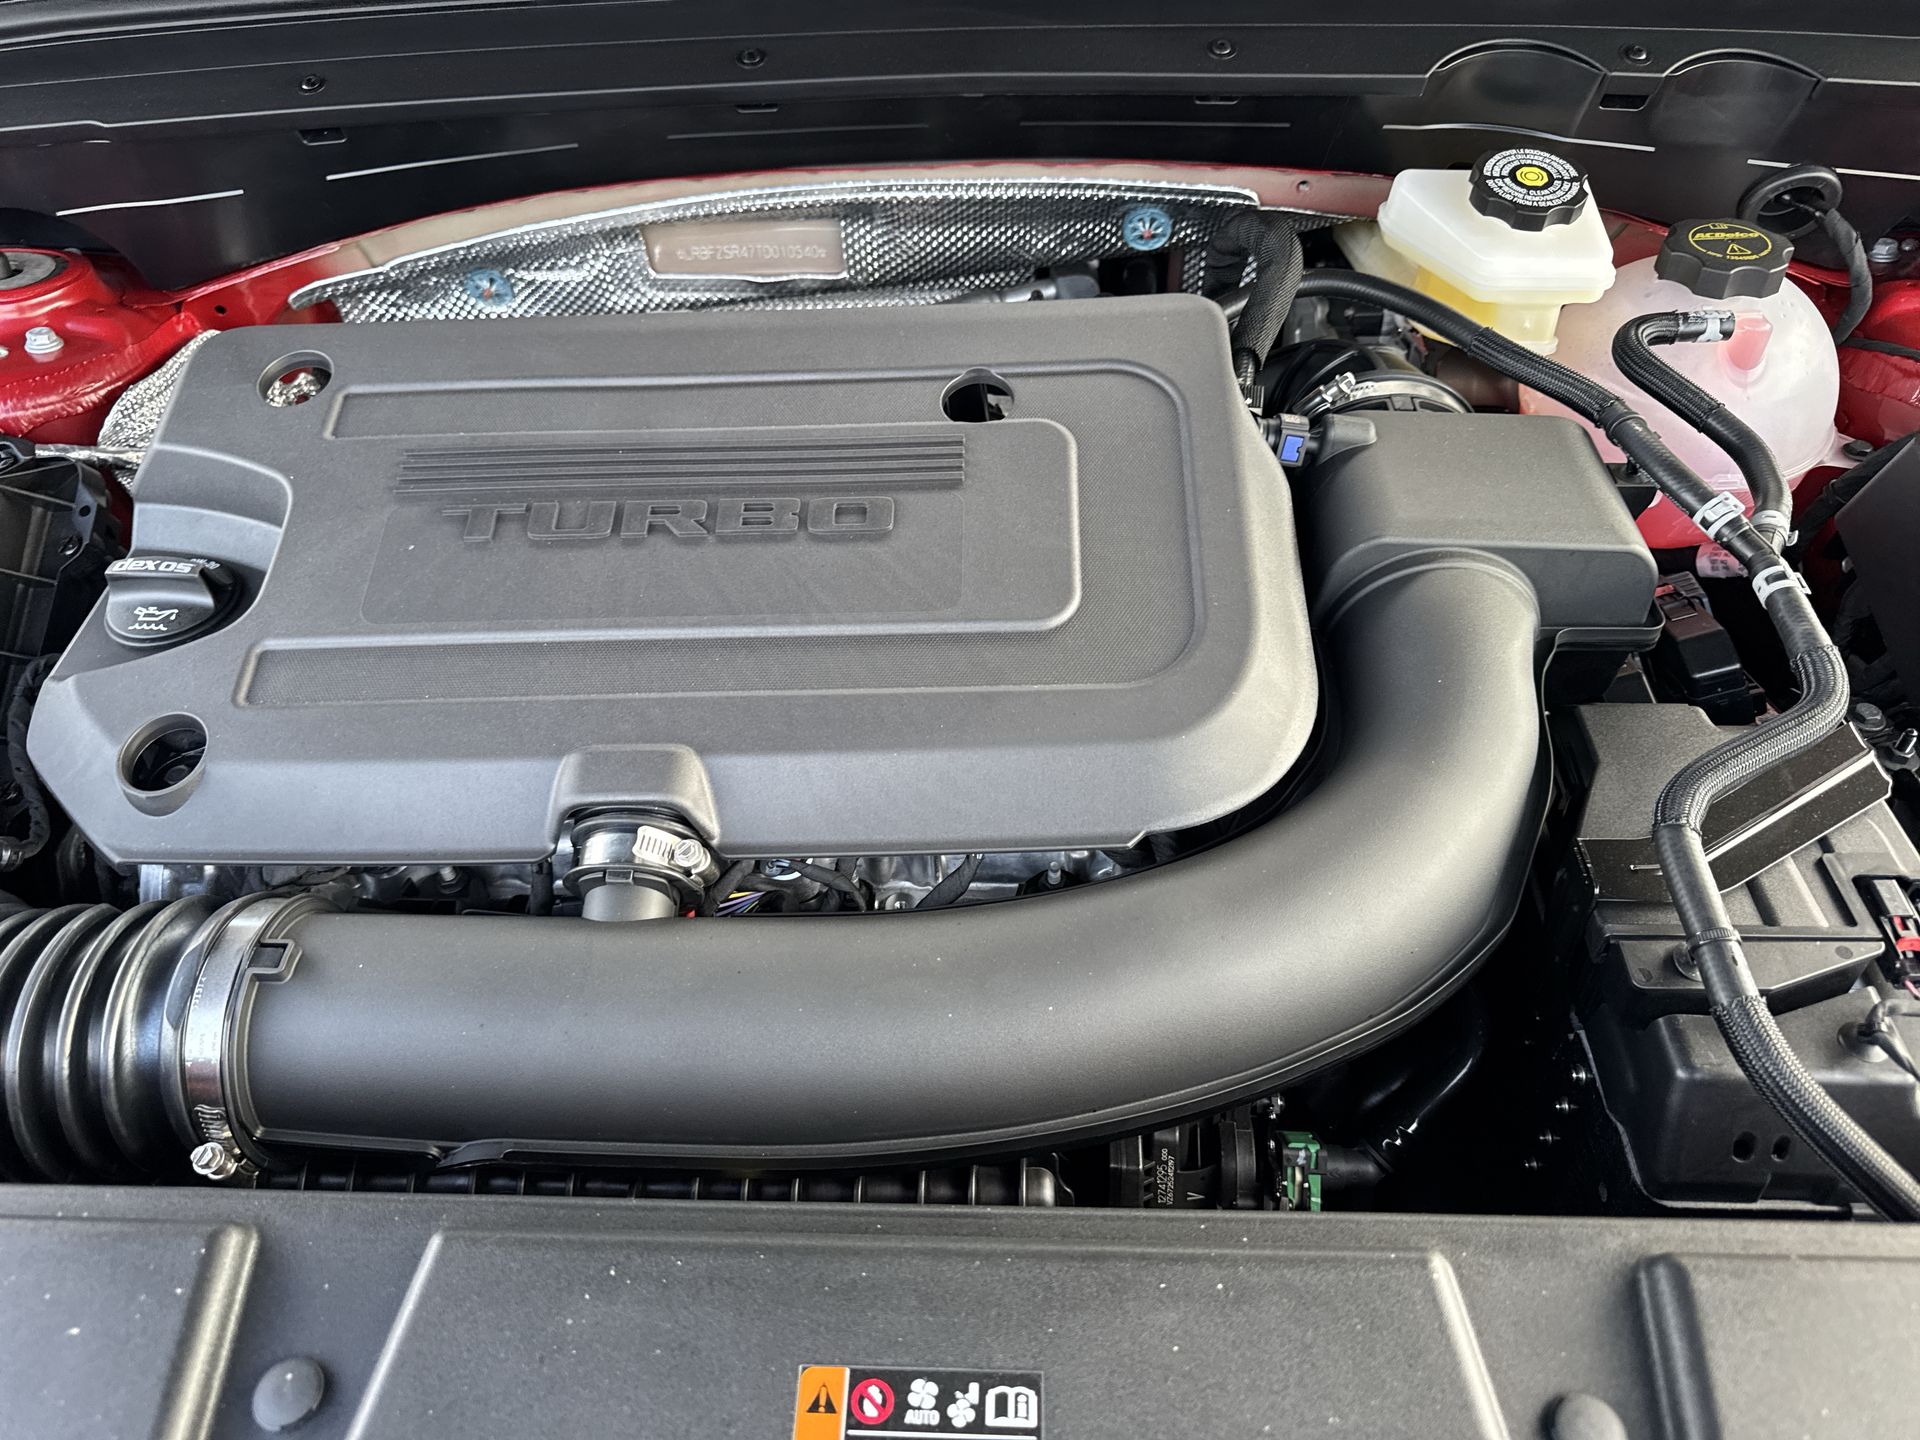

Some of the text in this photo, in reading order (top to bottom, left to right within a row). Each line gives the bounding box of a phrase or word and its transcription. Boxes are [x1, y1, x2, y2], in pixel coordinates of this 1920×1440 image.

[1496, 189, 1514, 201] FLUID
[1511, 197, 1531, 206] FROM
[1693, 231, 1760, 241] ACDelco
[441, 495, 896, 544] TURBO
[113, 558, 195, 574] dexos
[904, 1409, 940, 1425] AUTO
